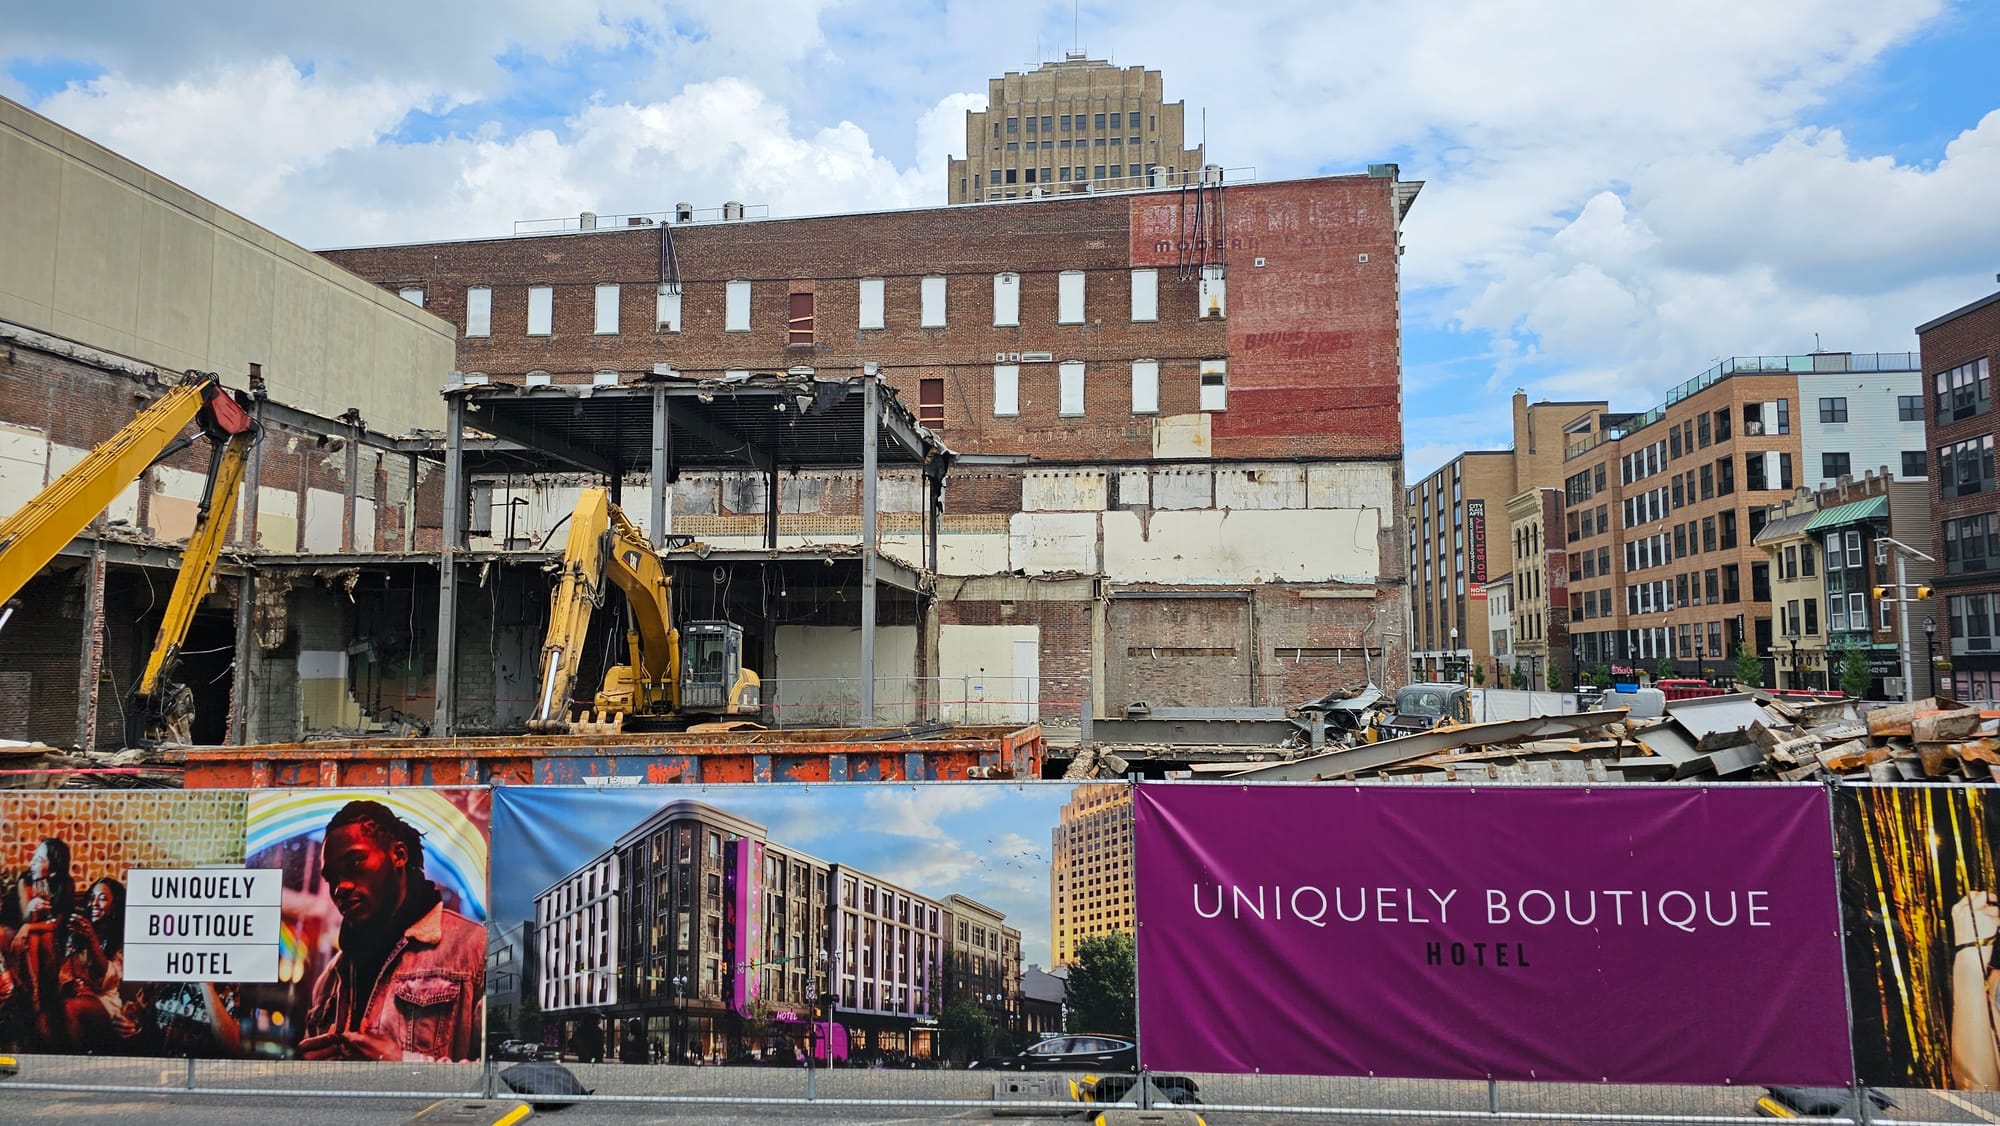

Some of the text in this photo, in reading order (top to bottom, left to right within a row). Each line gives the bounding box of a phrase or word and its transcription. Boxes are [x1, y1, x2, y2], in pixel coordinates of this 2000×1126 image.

[1475, 517, 1486, 581] 610.841.CITY
[151, 876, 256, 899] UNIQUELY
[1192, 884, 1772, 933] UNIQUELY BOUTIQUE
[149, 914, 254, 937] BOUTIQUE
[166, 952, 233, 975] HOTEL
[1426, 941, 1531, 968] HOTEL
[776, 1010, 798, 1021] HOTEL
